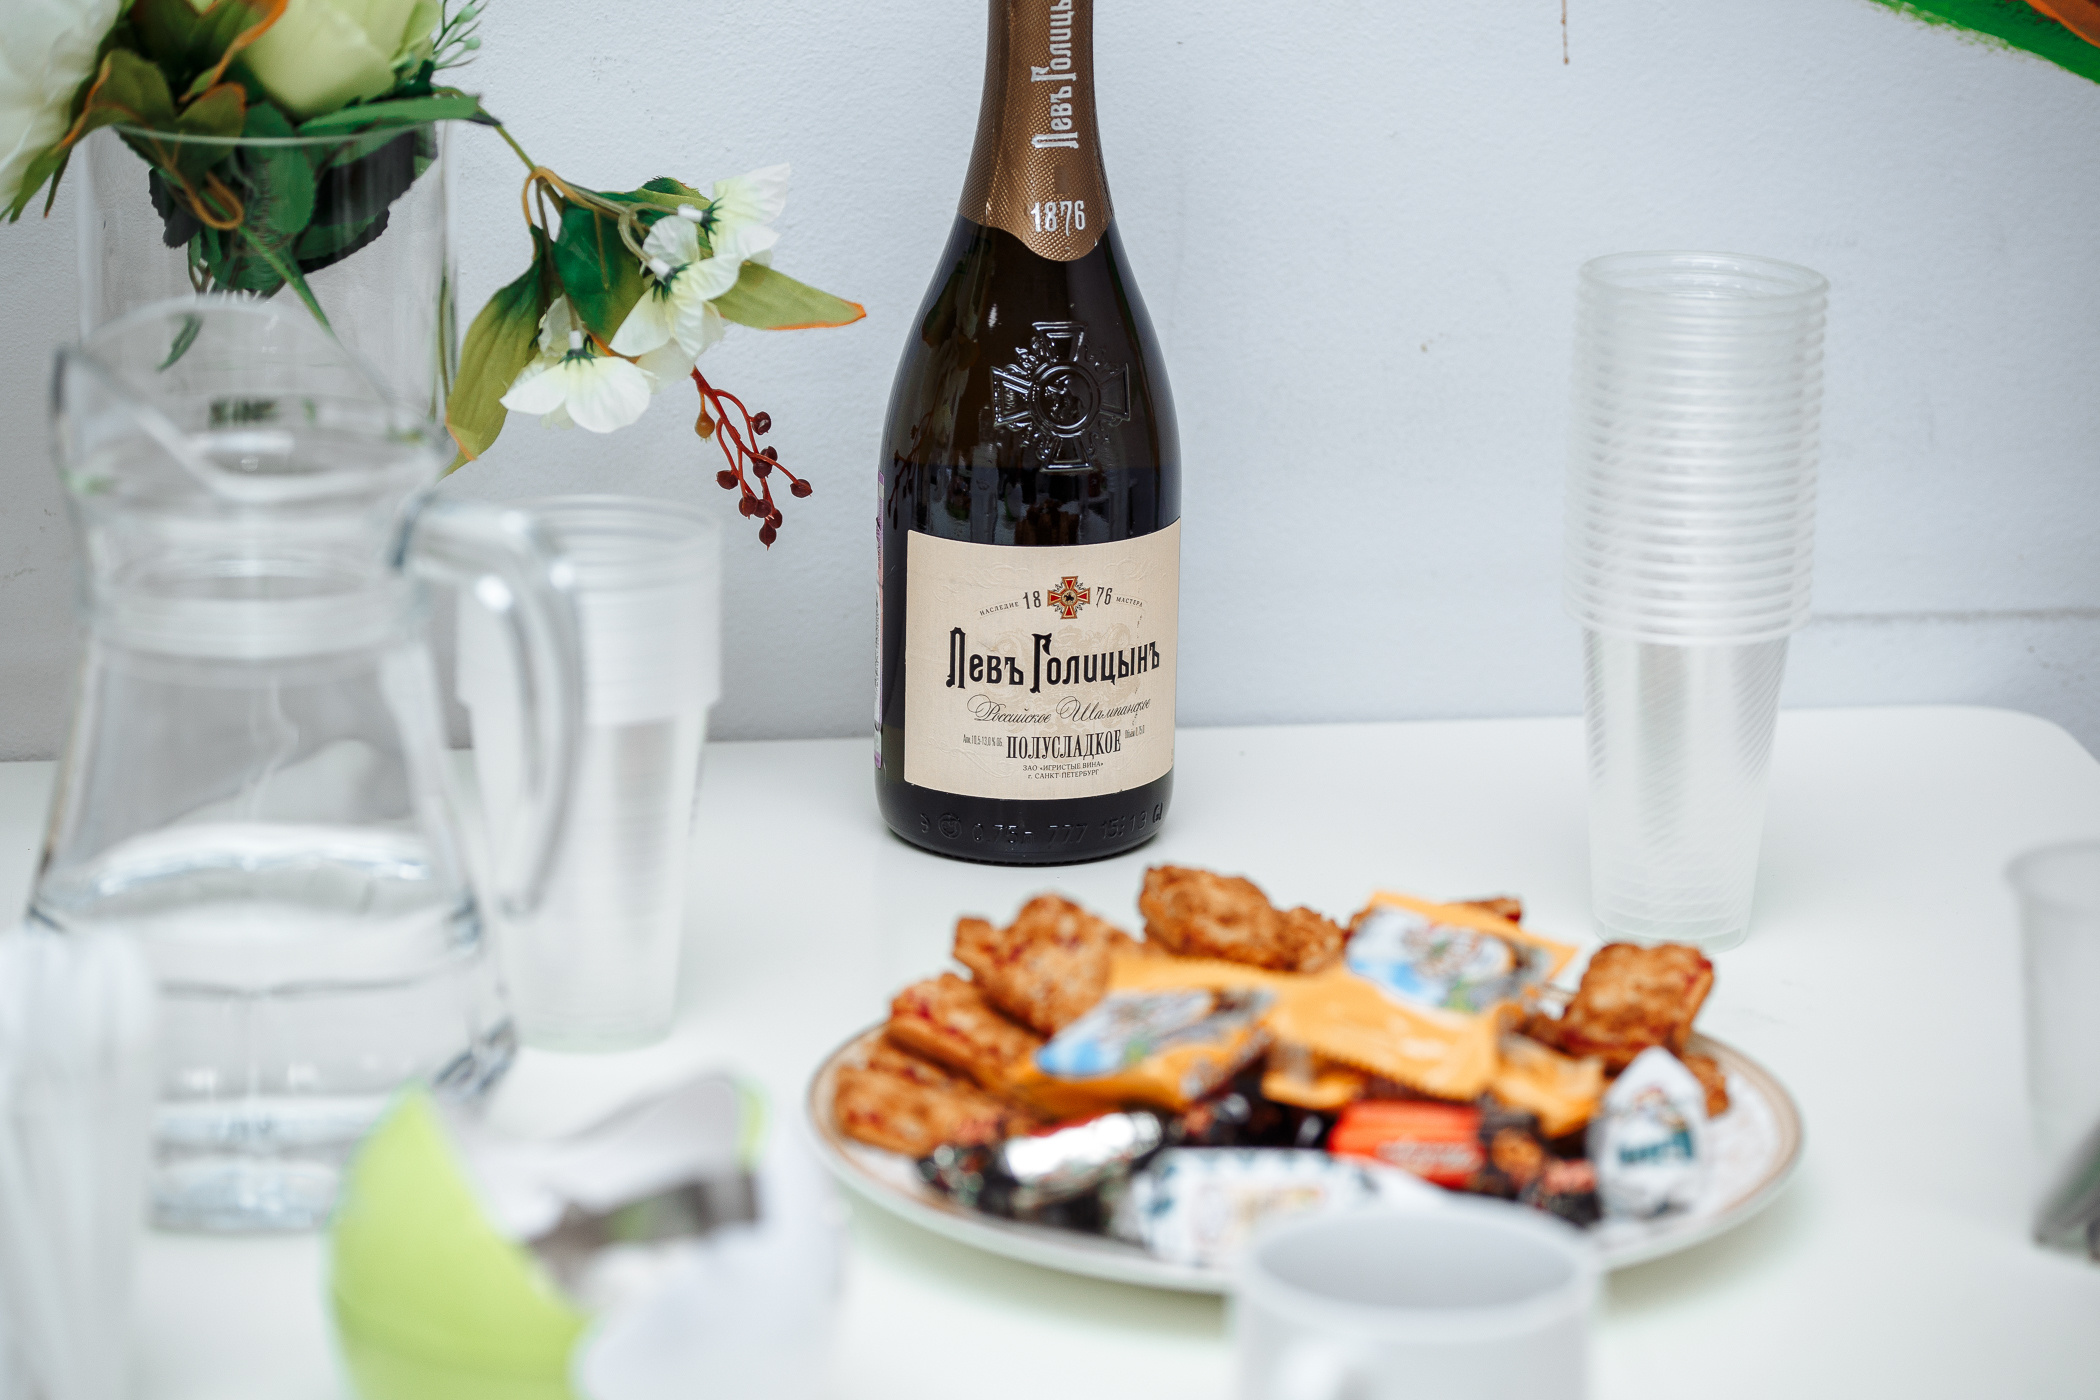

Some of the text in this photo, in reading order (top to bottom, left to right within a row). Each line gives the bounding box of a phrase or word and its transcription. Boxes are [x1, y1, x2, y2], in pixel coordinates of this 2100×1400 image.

[1031, 85, 1079, 149] Левъ
[1030, 200, 1086, 236] 1876
[1022, 590, 1042, 609] 18
[1095, 586, 1113, 608] 76
[1115, 596, 1143, 608] МАСТЕРА
[945, 626, 1024, 690] Левъ
[1029, 632, 1160, 694] Голицынъ
[967, 693, 1151, 724] Российское Шампанское
[1006, 729, 1121, 760] ПОЛУСЛАДКОЕ
[1039, 762, 1081, 771] «ИГРИСТЫЕ
[1083, 760, 1104, 769] ВИНА»
